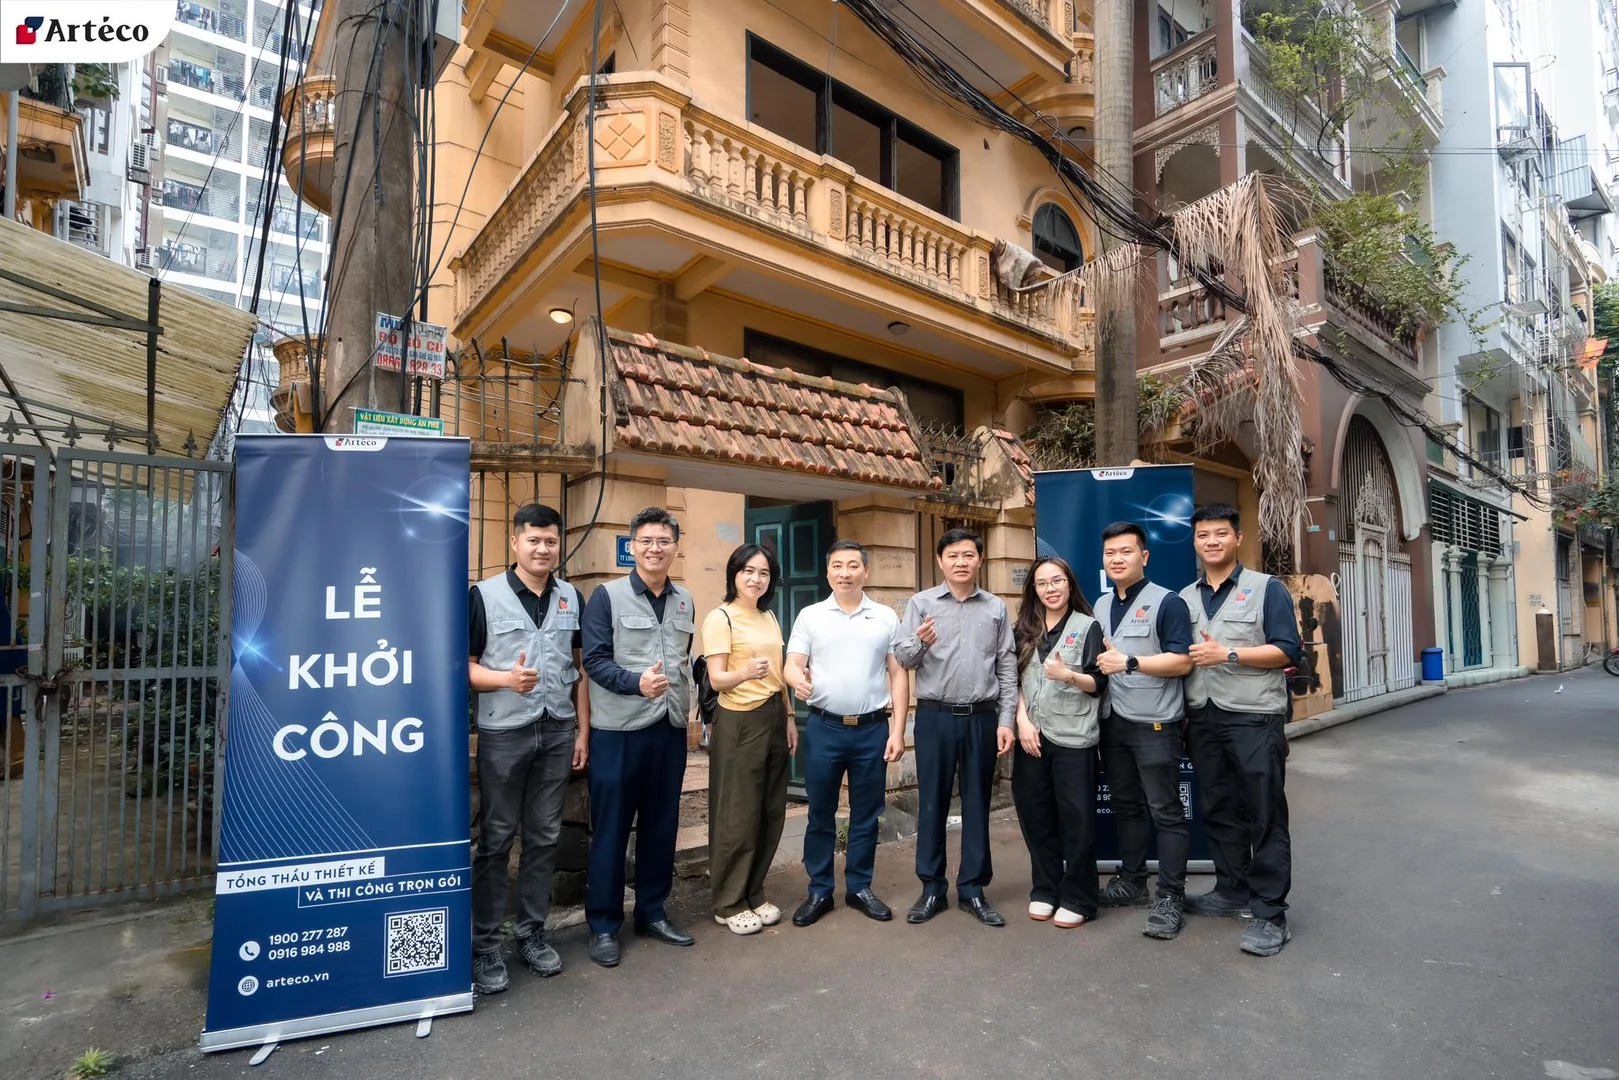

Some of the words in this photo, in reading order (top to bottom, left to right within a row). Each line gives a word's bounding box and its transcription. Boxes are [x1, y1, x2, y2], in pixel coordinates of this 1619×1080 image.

[387, 414, 398, 423] XÂY
[344, 437, 377, 446] Artéco
[1105, 469, 1127, 477] Artéco
[1100, 569, 1114, 593] L
[325, 566, 382, 620] LỄ
[288, 638, 413, 690] KHỞI
[272, 710, 425, 761] CÔNG
[226, 872, 267, 890] TỔNG
[271, 867, 310, 884] THẦU
[315, 863, 355, 881] THIẾT
[358, 860, 376, 876] KẾ
[305, 888, 324, 902] VÀ
[328, 887, 351, 900] THI
[355, 879, 394, 898] CÔNG
[398, 878, 434, 895] TRỌN
[438, 875, 461, 889] GÓI
[269, 932, 299, 946] 1900
[302, 929, 325, 942] 277
[326, 926, 349, 939] 287
[268, 946, 298, 961] 0916
[300, 943, 325, 957] 984
[327, 940, 351, 954] 988
[266, 972, 330, 989] arteco.vn
